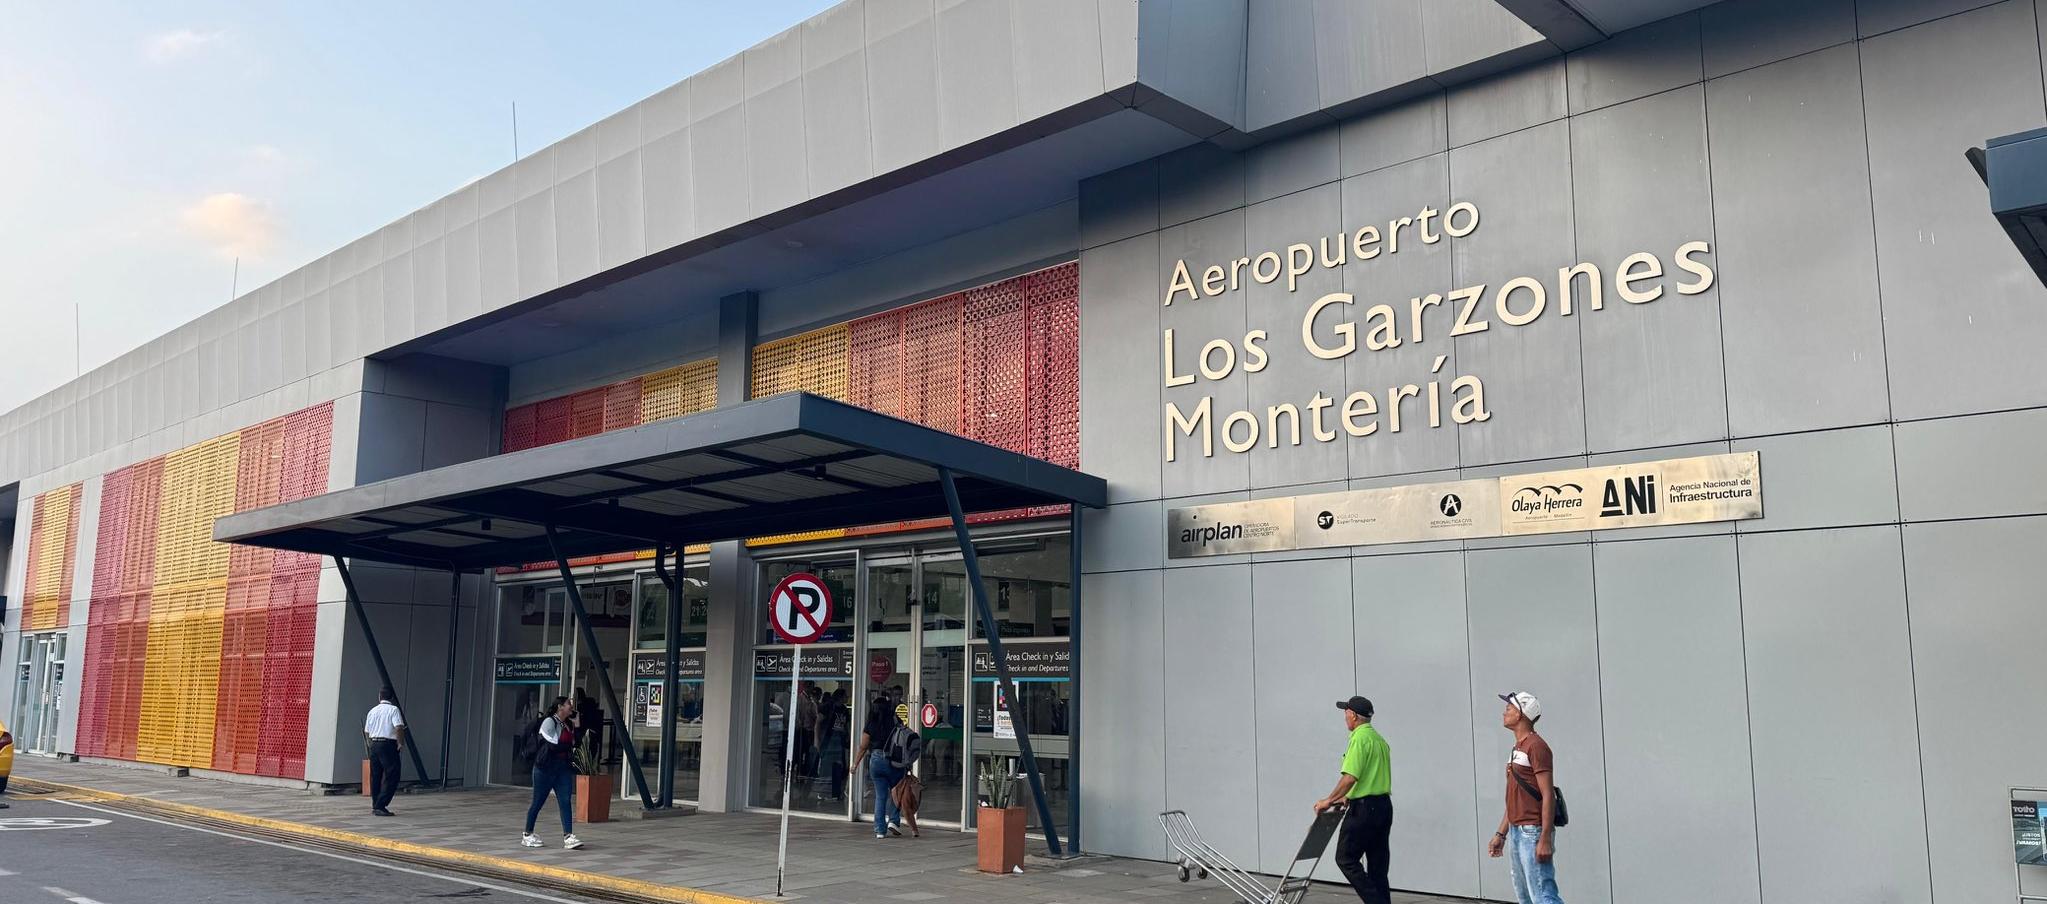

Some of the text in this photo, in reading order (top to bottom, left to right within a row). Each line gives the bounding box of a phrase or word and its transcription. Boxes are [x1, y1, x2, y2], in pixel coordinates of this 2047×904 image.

[1164, 201, 1481, 306] Aeropuerto
[1164, 240, 1716, 388] Los Garzones
[1166, 355, 1493, 462] Montería
[1669, 477, 1752, 495] Agencia Nacional de
[1669, 487, 1753, 504] Infraestructura
[1511, 493, 1583, 515] Olaya Herrera
[1181, 514, 1243, 547] airplan
[1318, 515, 1334, 526] ST
[788, 586, 821, 631] P
[845, 661, 853, 674] 5
[1006, 650, 1021, 661] Área
[1022, 652, 1042, 661] Check
[1050, 654, 1055, 663] y
[1055, 652, 1070, 661] Salid
